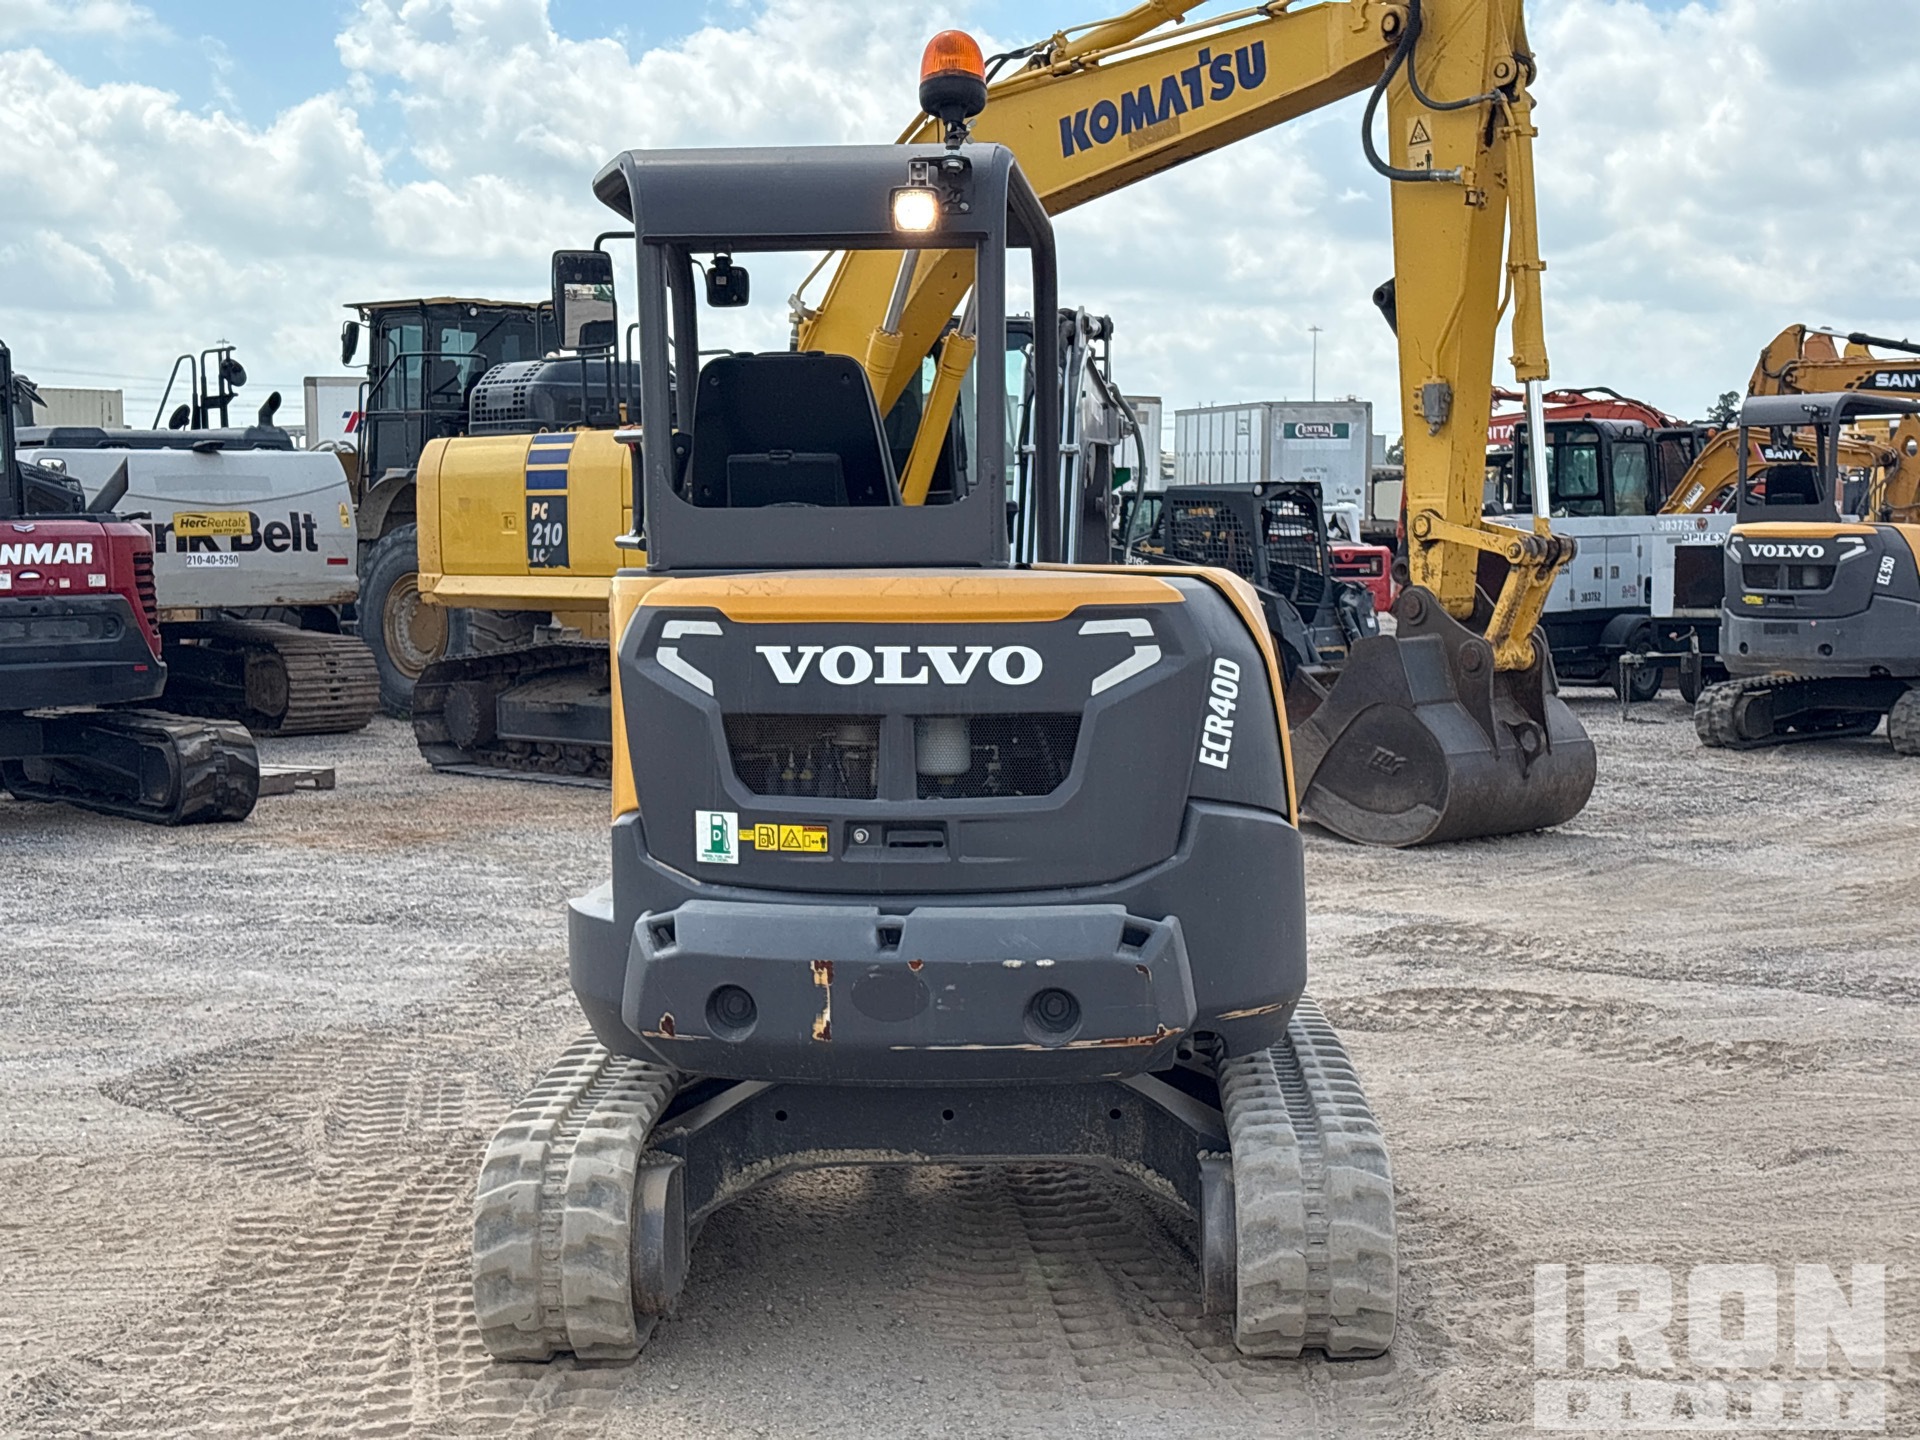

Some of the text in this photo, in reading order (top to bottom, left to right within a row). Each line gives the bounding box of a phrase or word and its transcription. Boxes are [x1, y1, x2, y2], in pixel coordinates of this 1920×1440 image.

[1060, 40, 1266, 158] KOMATSU
[1295, 423, 1338, 438] CENTRAL
[1765, 449, 1803, 461] SANY
[531, 502, 549, 520] PC
[180, 517, 247, 529] HercRentals
[531, 522, 563, 546] 210
[1748, 544, 1825, 558] VOLVO
[755, 645, 1043, 685] VOLVO
[1199, 657, 1240, 770] ECR40D
